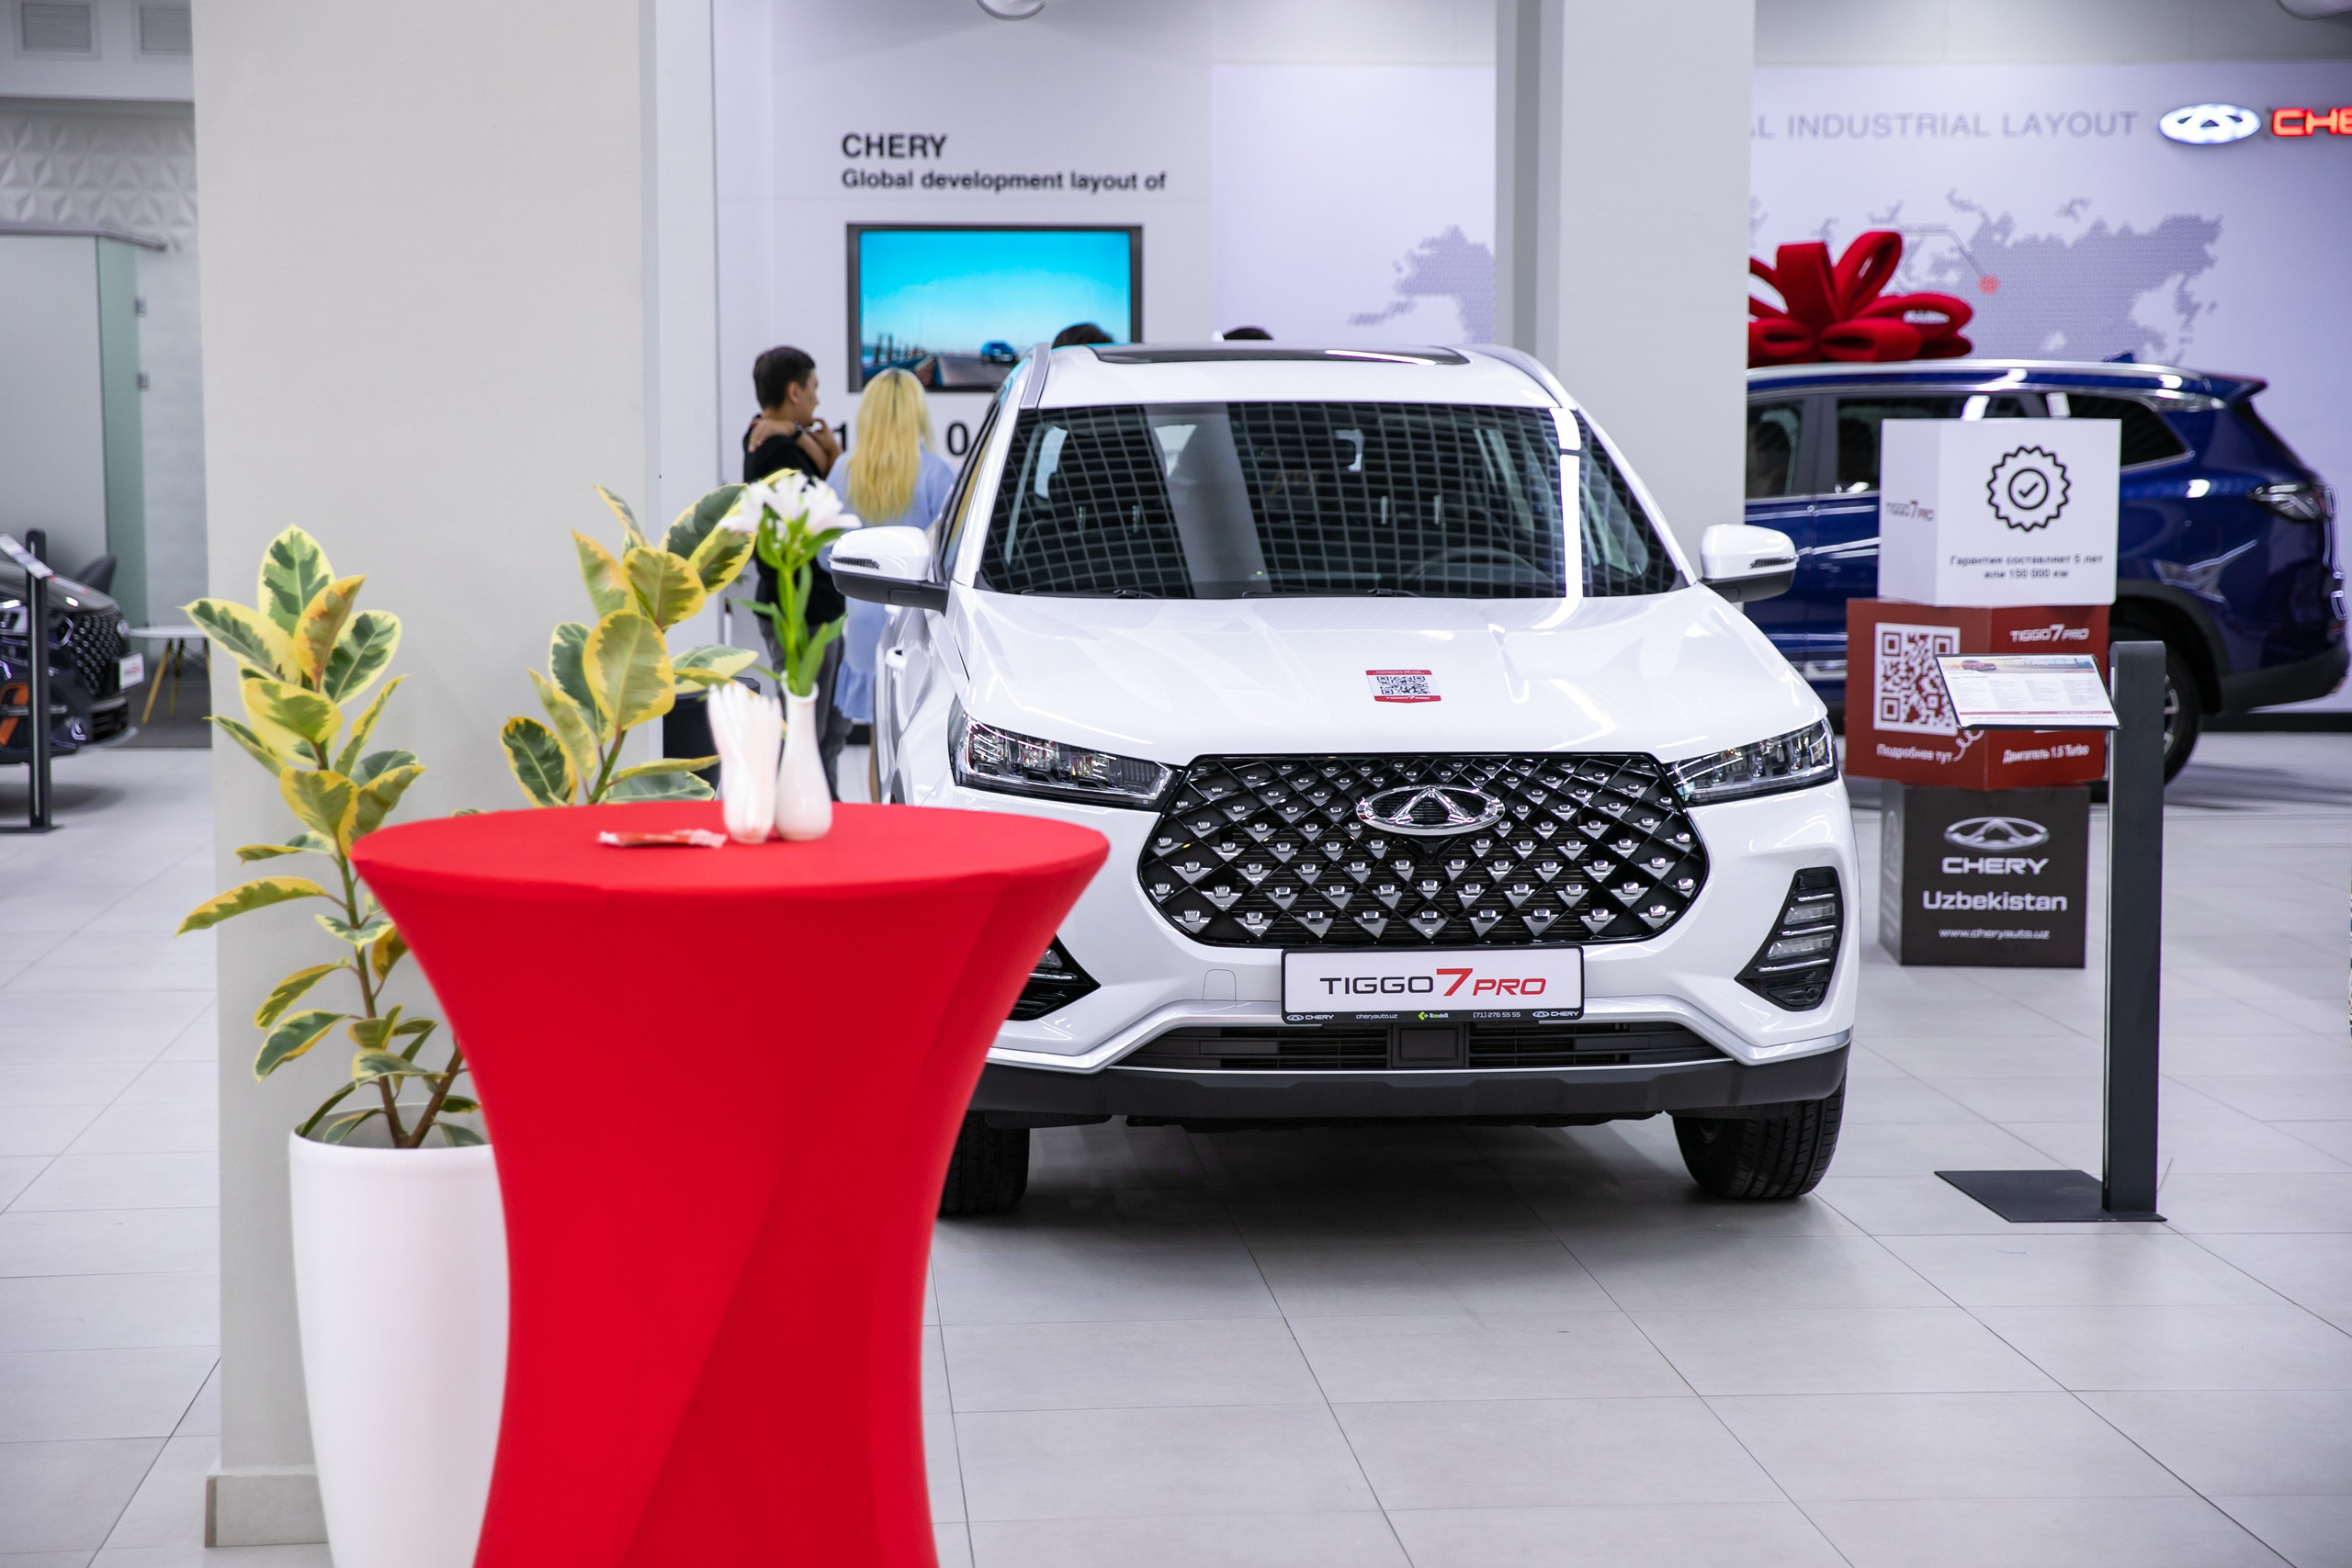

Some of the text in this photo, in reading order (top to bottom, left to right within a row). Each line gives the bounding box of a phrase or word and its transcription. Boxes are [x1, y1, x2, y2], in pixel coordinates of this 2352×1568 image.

[1750, 110, 2137, 140] L INDUSTRIAL LAYOUT
[842, 133, 947, 158] CHERY
[842, 168, 1167, 196] Global development layout of
[1876, 743, 1953, 765] Подробнее тут
[2002, 749, 2051, 764] Двигатель
[2064, 743, 2090, 758] Turbo
[1941, 856, 2050, 874] CHERY
[1922, 890, 2067, 911] Uzbekistan
[1939, 928, 2051, 941] www.cheryauto.uz
